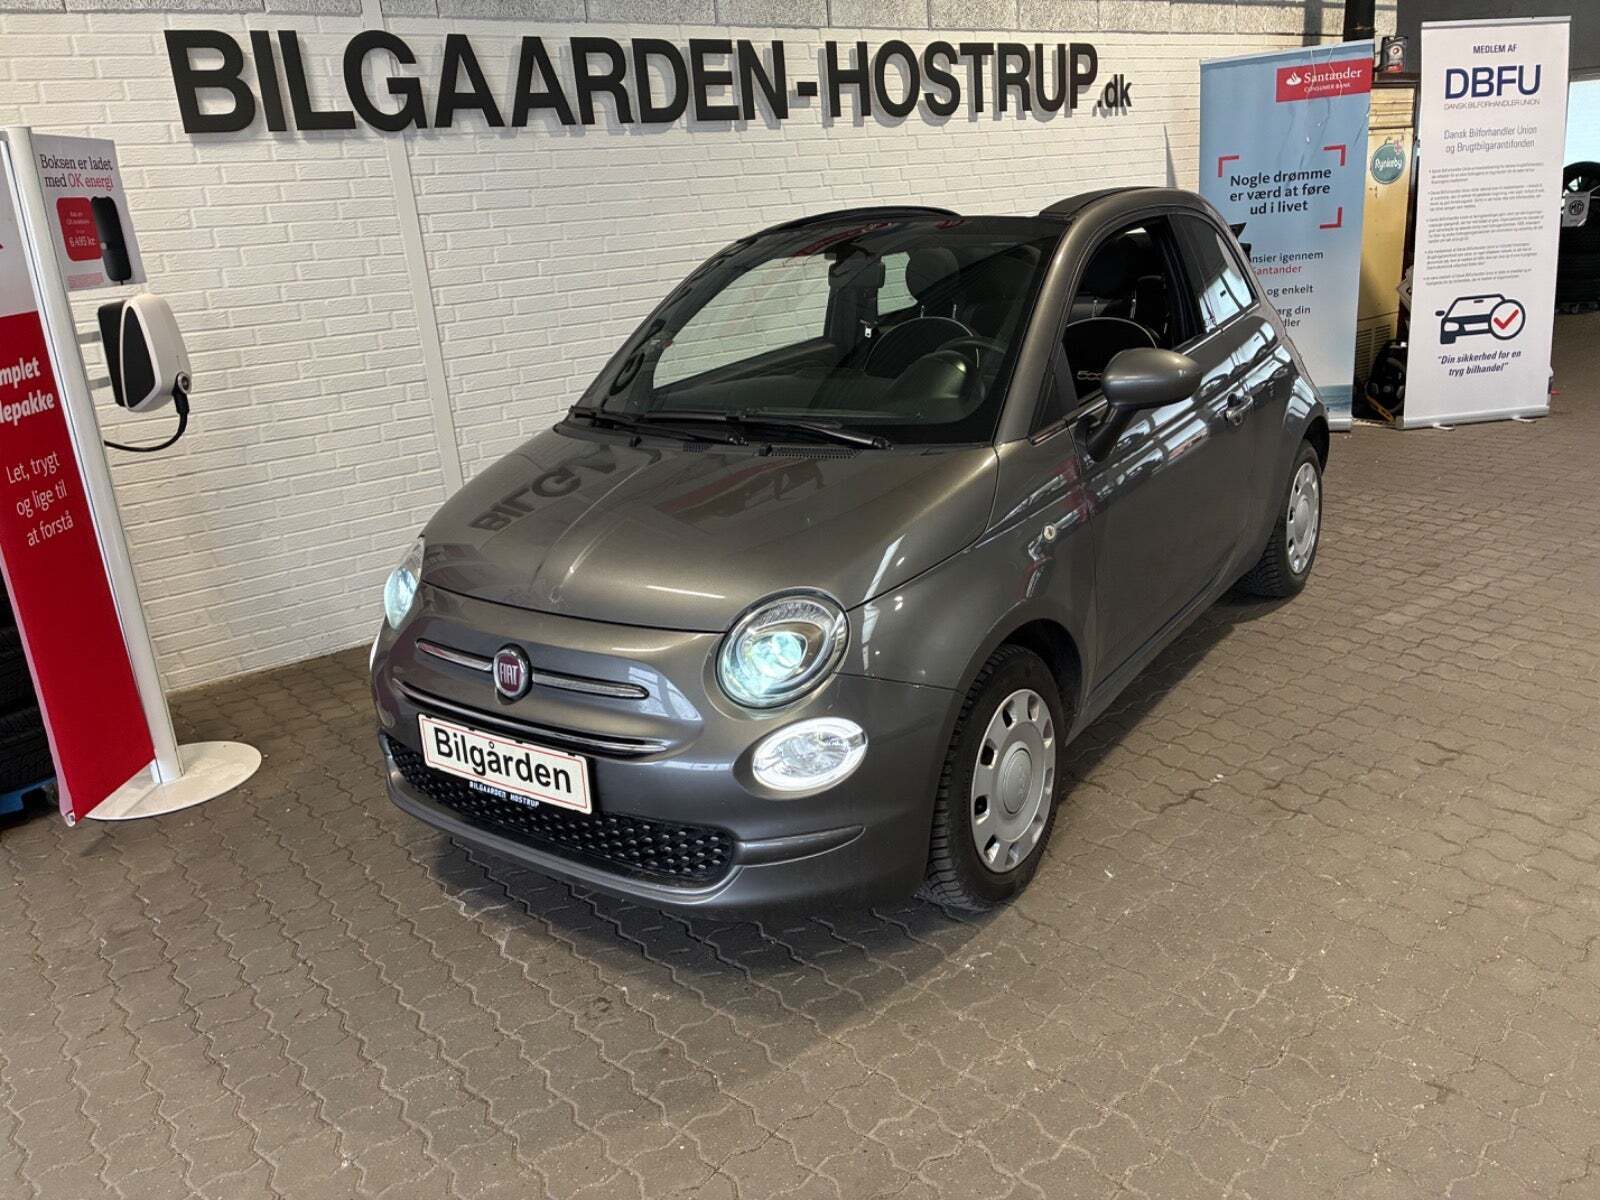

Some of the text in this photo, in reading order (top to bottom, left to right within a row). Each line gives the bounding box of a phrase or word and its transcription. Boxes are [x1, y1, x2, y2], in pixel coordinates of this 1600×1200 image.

[1473, 44, 1518, 54] MEDLEM AF
[1303, 67, 1362, 84] Santander
[1445, 64, 1541, 99] DBFU
[1444, 125, 1538, 140] Dansk Bilforhandler Union
[1445, 139, 1535, 154] og Brugtbilgarantifonden
[40, 154, 113, 171] Boksen er ladet
[45, 173, 113, 192] med OK energi
[1230, 168, 1332, 188] Nogle drømme
[1230, 183, 1331, 202] er værd at føre
[1250, 200, 1308, 215] ud i livet
[1251, 252, 1324, 264] nsier igennem
[1266, 284, 1314, 297] og enkelt
[1294, 305, 1311, 315] din
[1457, 350, 1498, 363] sikkerhed
[1498, 350, 1510, 359] for
[1511, 350, 1522, 358] en
[0, 357, 41, 389] mplet
[1448, 367, 1465, 377] tryg
[6, 451, 60, 484] Let, trygt
[16, 479, 67, 518] og lige til
[26, 510, 74, 547] at forstå
[500, 662, 519, 686] FIAT
[434, 727, 572, 794] Bilgården
[469, 781, 540, 808] BILGAARDEN HOSTRUP
